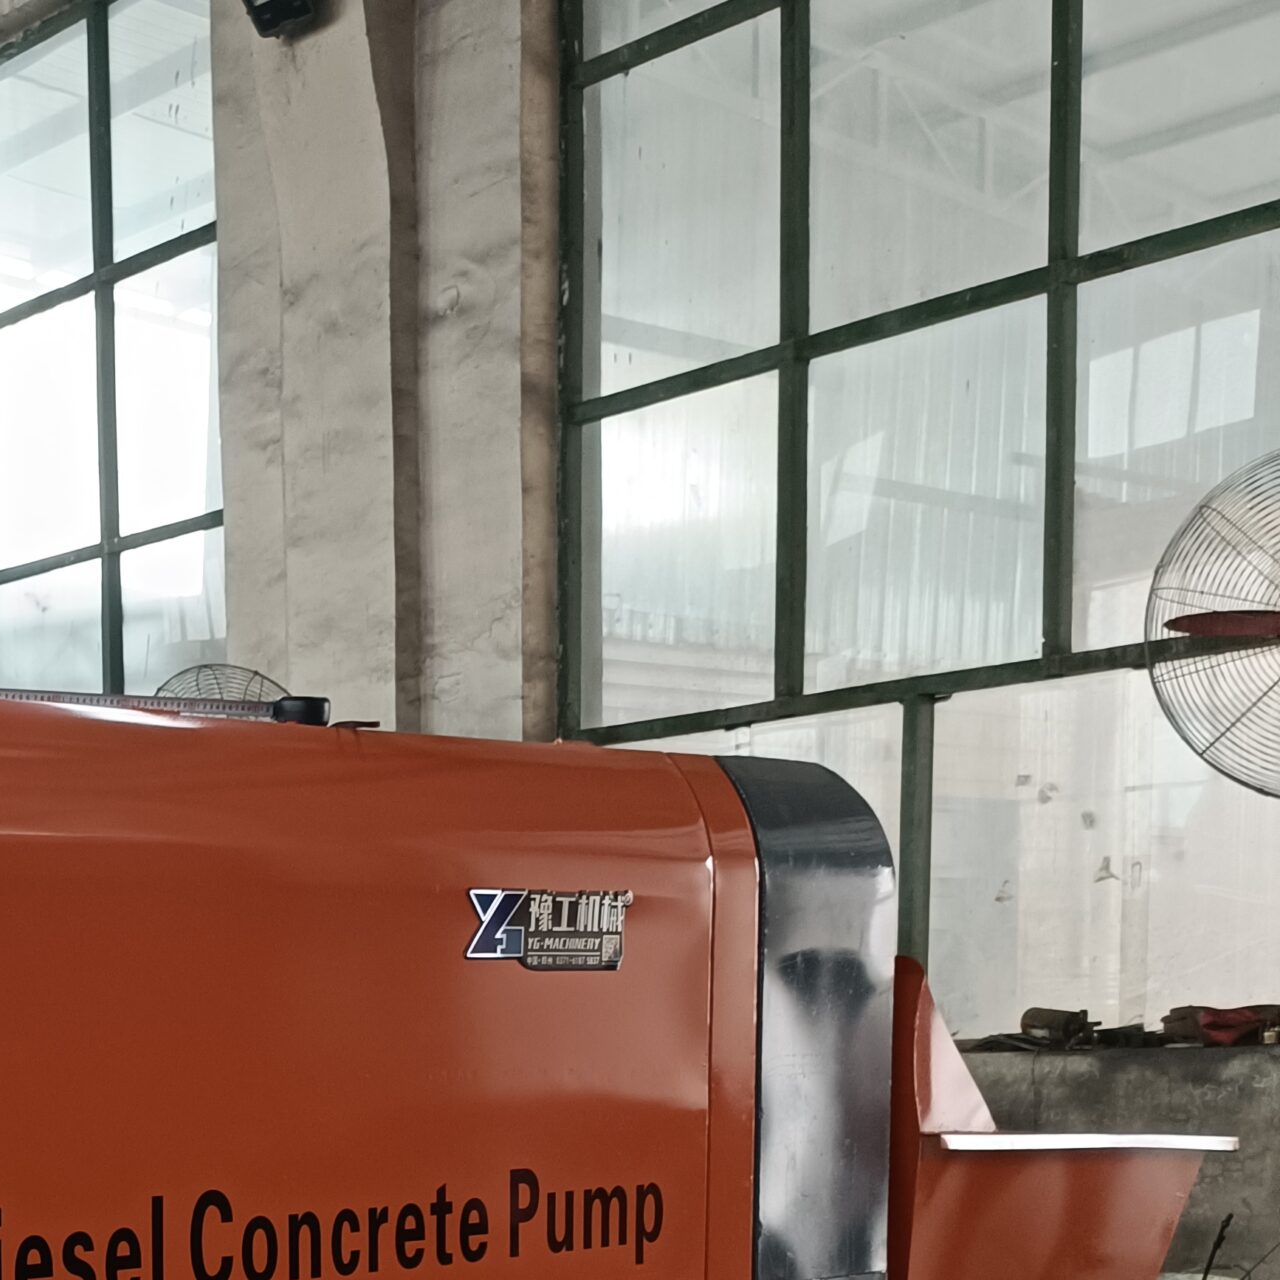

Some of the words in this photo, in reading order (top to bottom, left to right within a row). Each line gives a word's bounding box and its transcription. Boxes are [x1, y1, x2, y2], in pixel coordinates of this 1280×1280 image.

[528, 893, 625, 932] 豫工机械
[509, 1168, 664, 1265] Pump
